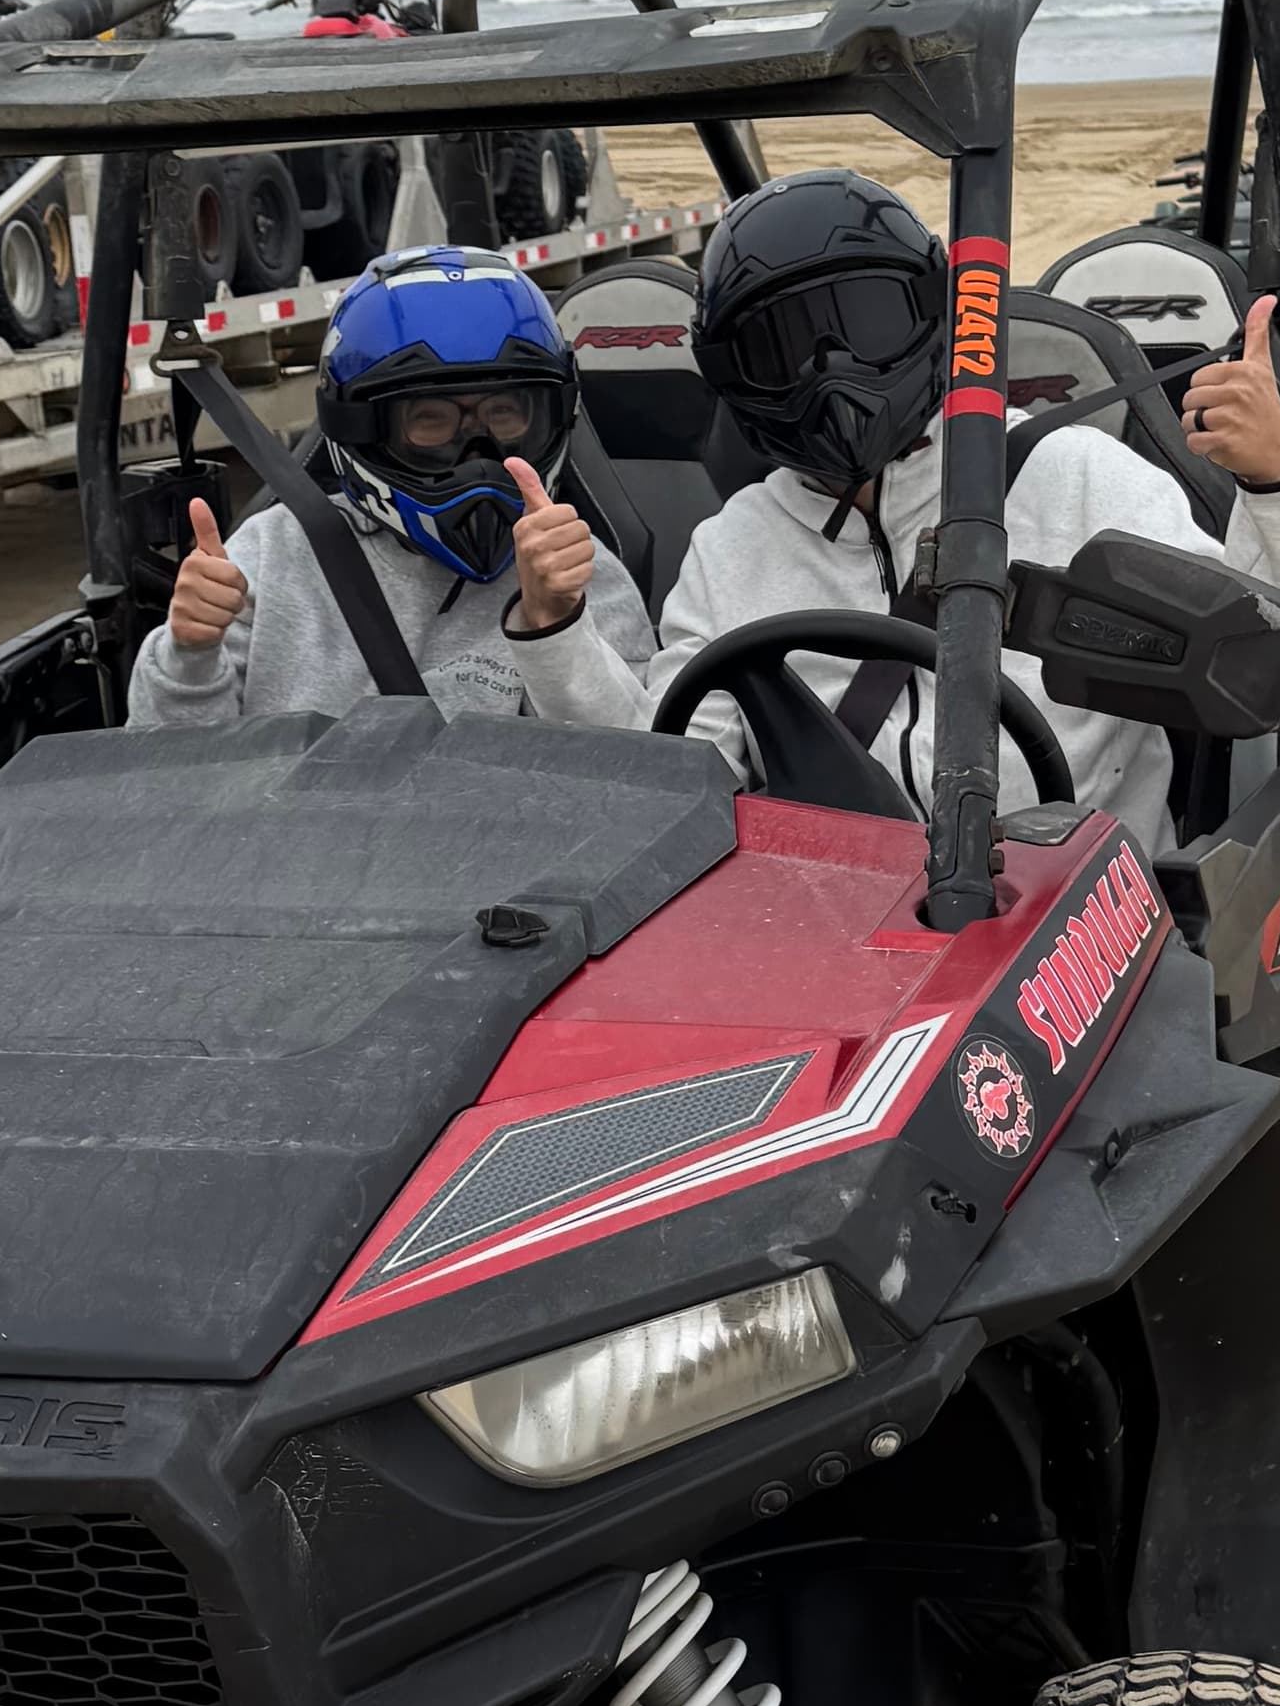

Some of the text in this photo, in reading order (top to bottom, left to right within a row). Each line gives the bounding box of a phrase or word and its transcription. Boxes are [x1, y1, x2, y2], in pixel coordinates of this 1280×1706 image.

[573, 325, 688, 350] RZR
[952, 270, 1000, 377] UZ412
[1017, 839, 1161, 1076] SUNBUGGY
